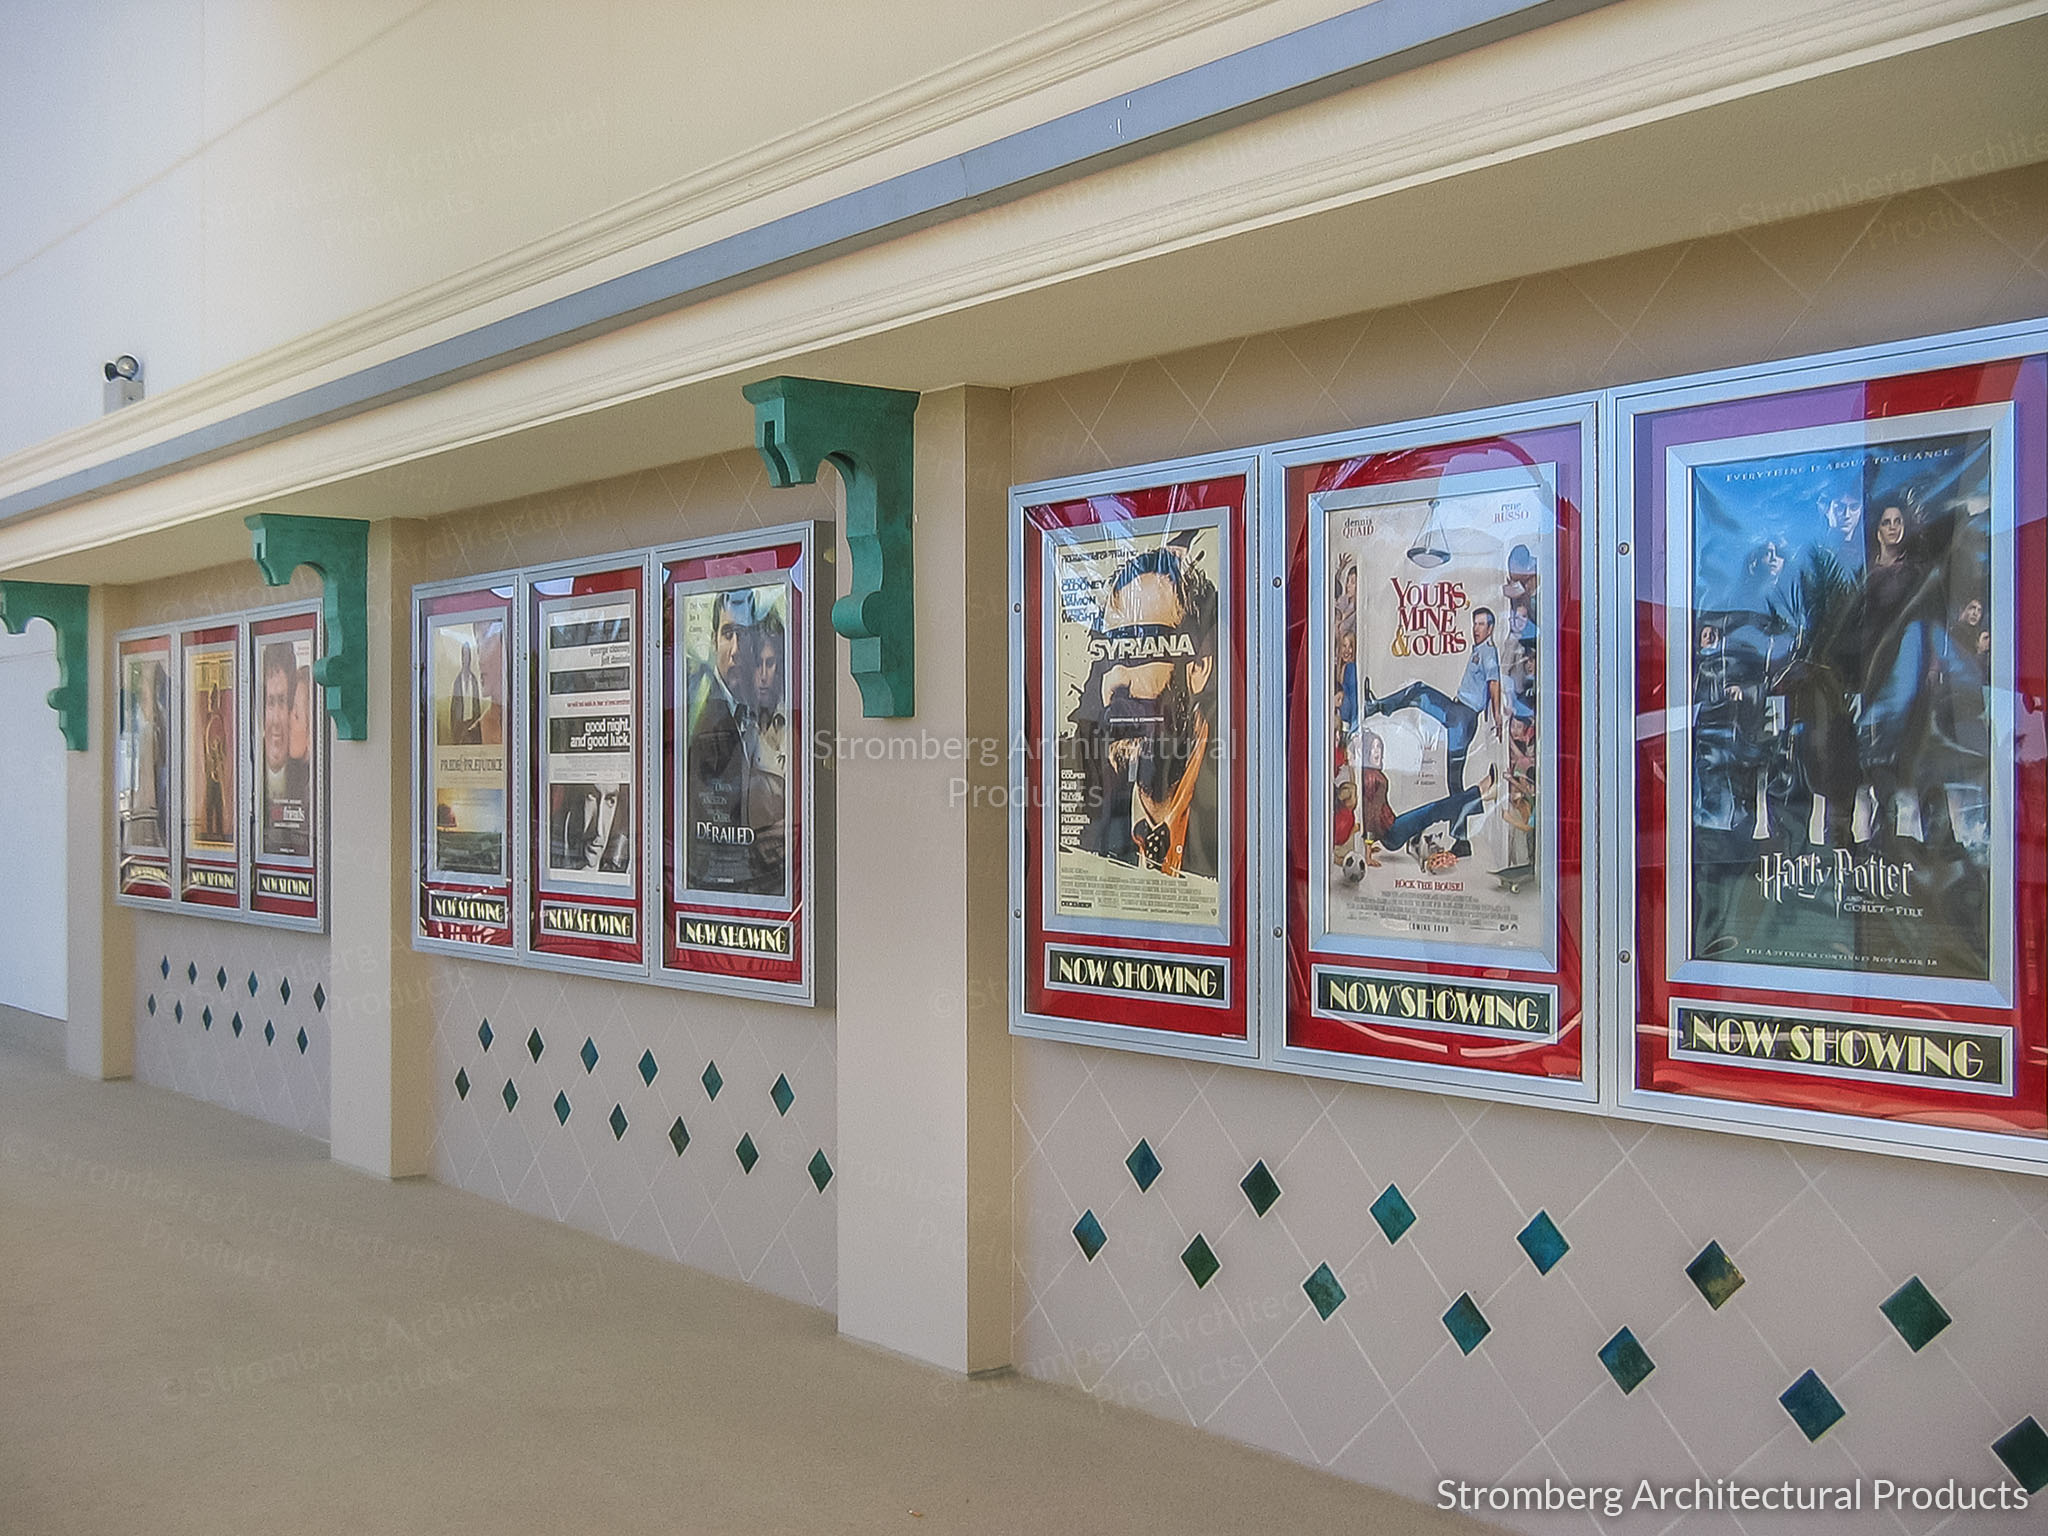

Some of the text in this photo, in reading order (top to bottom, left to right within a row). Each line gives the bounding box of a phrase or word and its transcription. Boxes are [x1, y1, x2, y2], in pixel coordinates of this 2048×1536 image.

[1826, 457, 1867, 472] ABOUT
[1873, 456, 1890, 465] TO
[1342, 524, 1374, 538] QUAID
[1398, 606, 1458, 634] MINE
[1089, 633, 1195, 660] SYRIANA
[1412, 631, 1467, 657] OURS
[584, 719, 606, 734] good
[570, 735, 587, 748] and
[586, 733, 609, 750] good
[696, 821, 755, 846] DERAILED
[1755, 848, 1915, 920] Harry Potter
[686, 922, 718, 945] NOW
[1059, 956, 1217, 997] NOW SHOWING
[1329, 978, 1540, 1031] NOW SHOWING
[1690, 1011, 1984, 1080] NOW SHOWING
